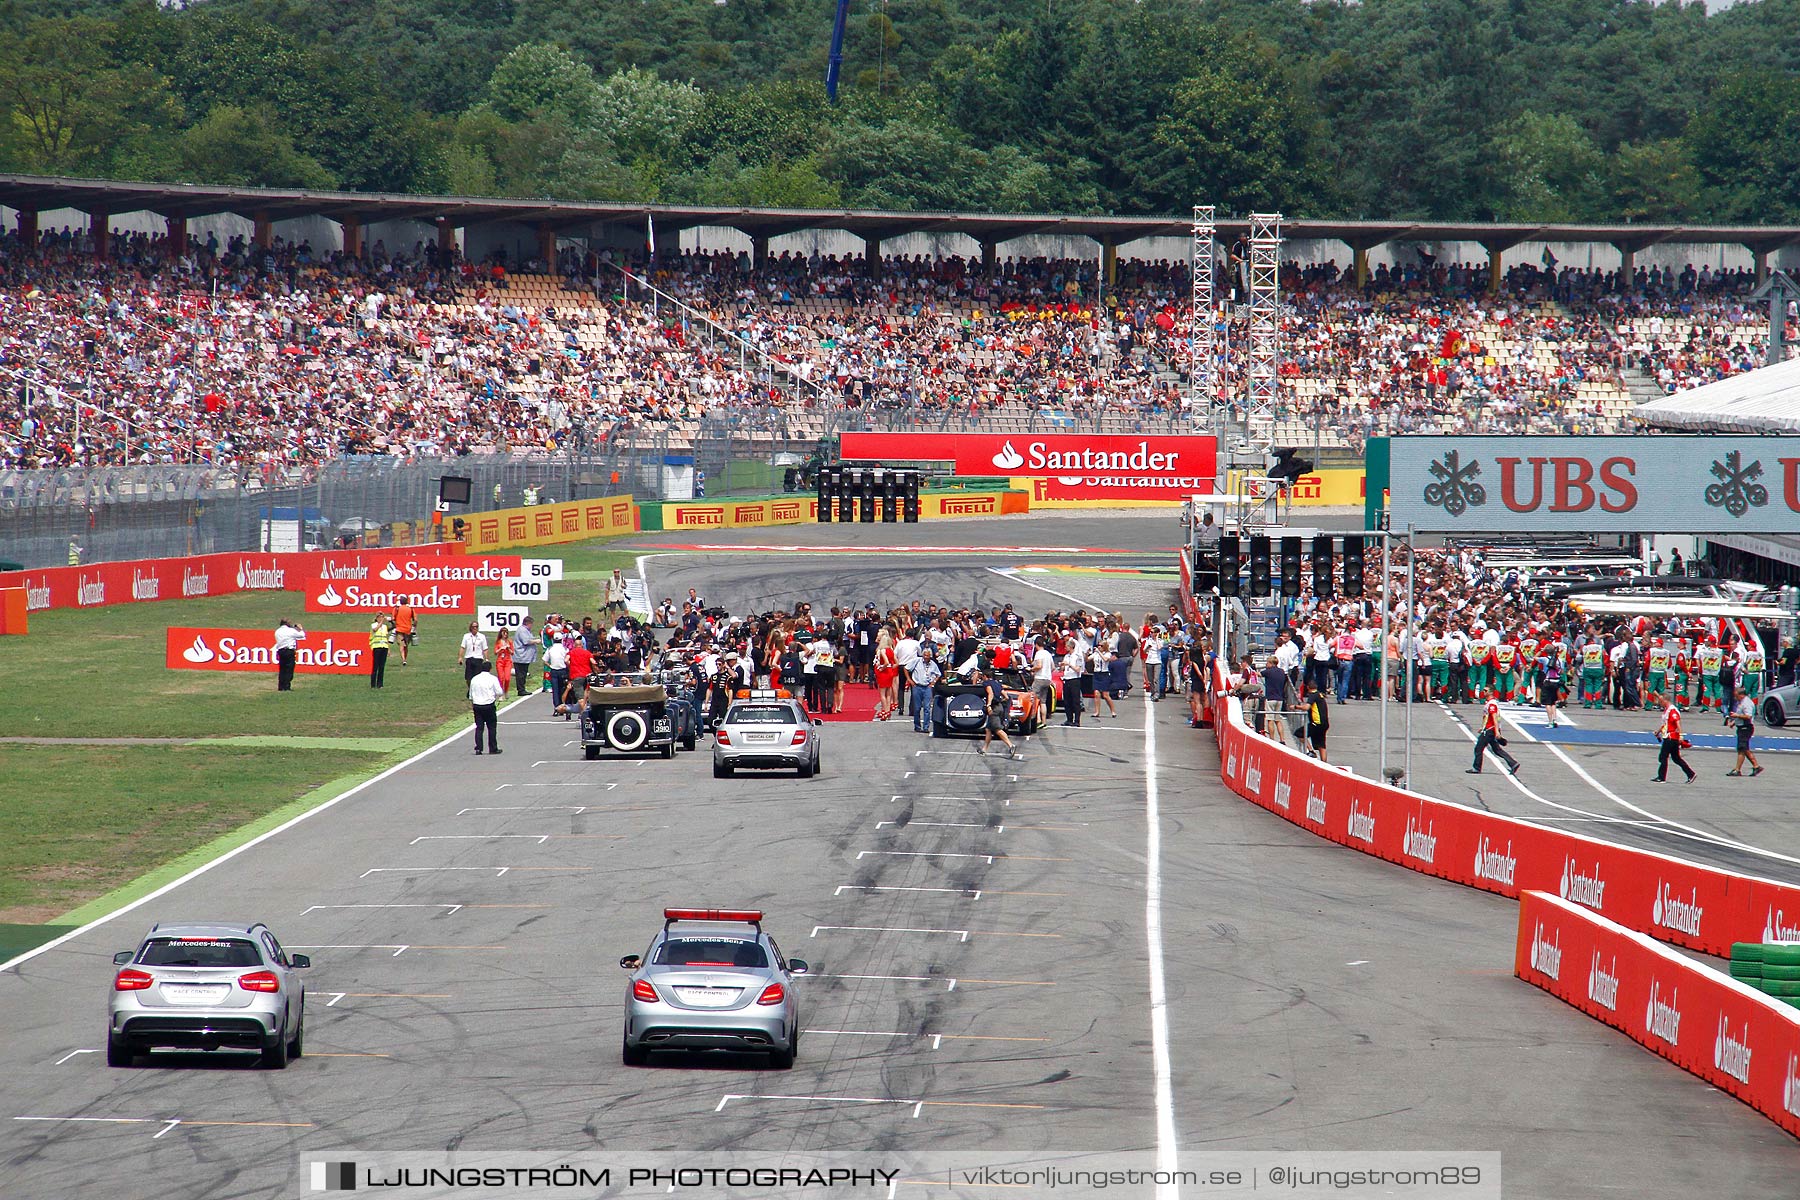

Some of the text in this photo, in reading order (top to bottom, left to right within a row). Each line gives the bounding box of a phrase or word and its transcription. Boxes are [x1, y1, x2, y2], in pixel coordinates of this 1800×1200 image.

[1028, 441, 1179, 471] Santander
[1495, 456, 1638, 513] UBS
[676, 507, 724, 525] PIRELLI
[734, 505, 764, 523] PIRELLI
[771, 502, 800, 520] PIRELLI
[940, 497, 996, 515] PIRELLI
[245, 558, 285, 589] Santander
[329, 556, 369, 579] Santander
[404, 559, 511, 581] Santander
[531, 564, 551, 576] 50
[510, 582, 541, 596] 100
[485, 612, 520, 627] 150
[218, 637, 362, 667] Santnder
[1481, 836, 1516, 886] Santander
[1568, 858, 1605, 910] Santander
[1662, 882, 1703, 937] Santander
[167, 940, 231, 948] Mercedes-Benz
[681, 937, 744, 945] Mercedes-Benz
